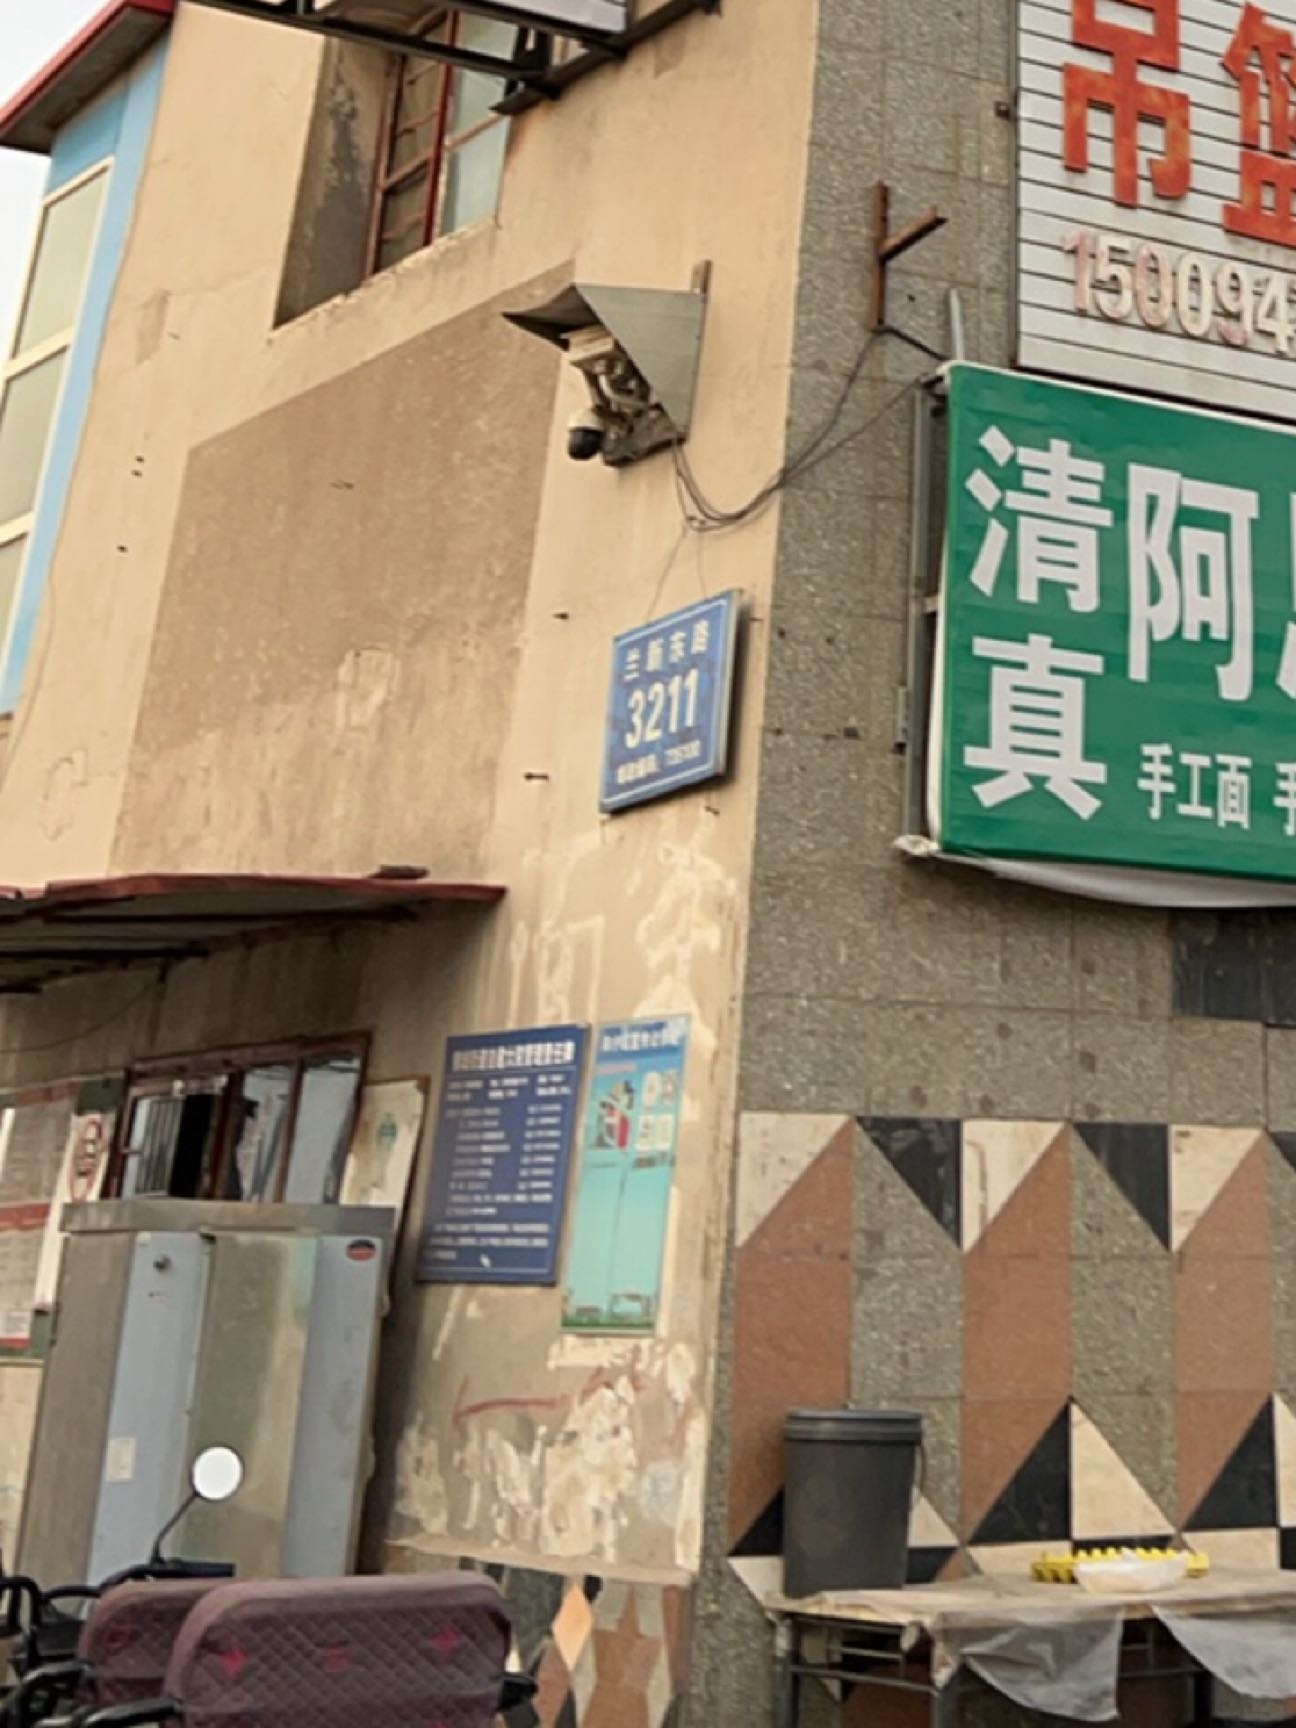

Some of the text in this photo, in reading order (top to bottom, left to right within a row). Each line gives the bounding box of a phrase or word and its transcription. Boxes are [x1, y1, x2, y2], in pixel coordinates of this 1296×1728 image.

[964, 425, 1113, 820] 清真
[625, 669, 699, 748] 3211
[1137, 743, 1252, 830] 手工面
